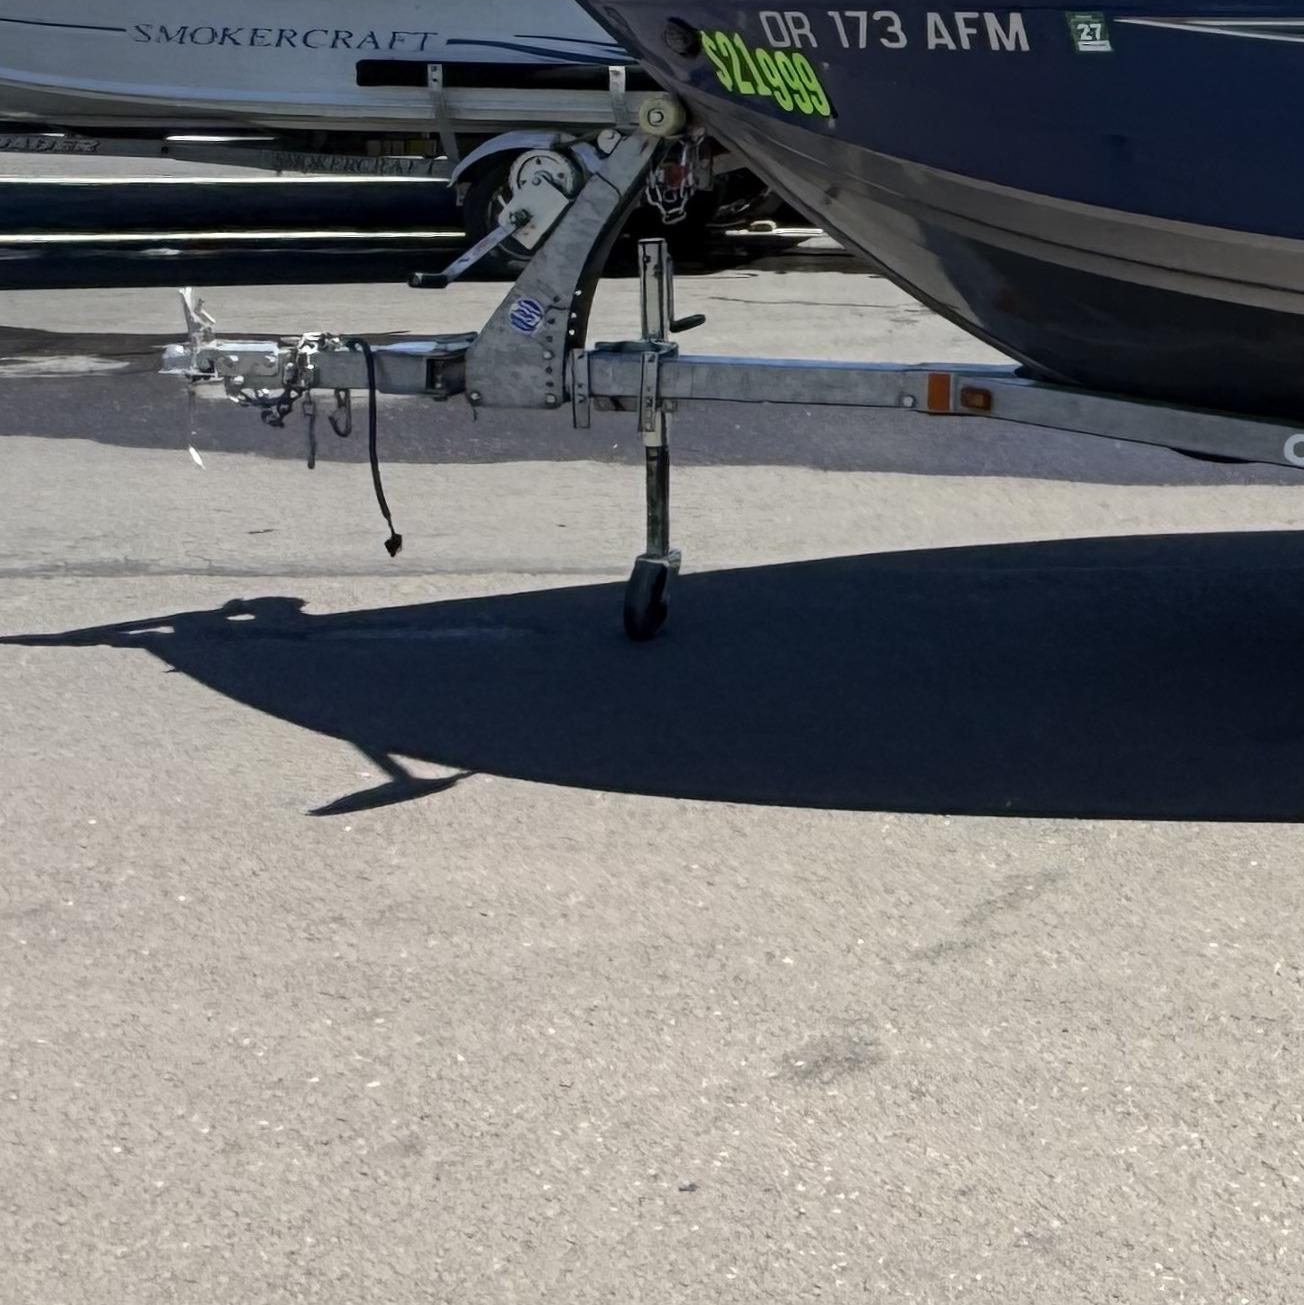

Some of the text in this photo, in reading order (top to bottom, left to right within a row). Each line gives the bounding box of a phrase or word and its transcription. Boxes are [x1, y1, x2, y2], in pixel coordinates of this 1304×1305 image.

[132, 23, 438, 52] SMOKERCRAFT
[759, 11, 1031, 52] OR 173 AFM
[1077, 23, 1102, 41] 27
[701, 30, 831, 116] $21999
